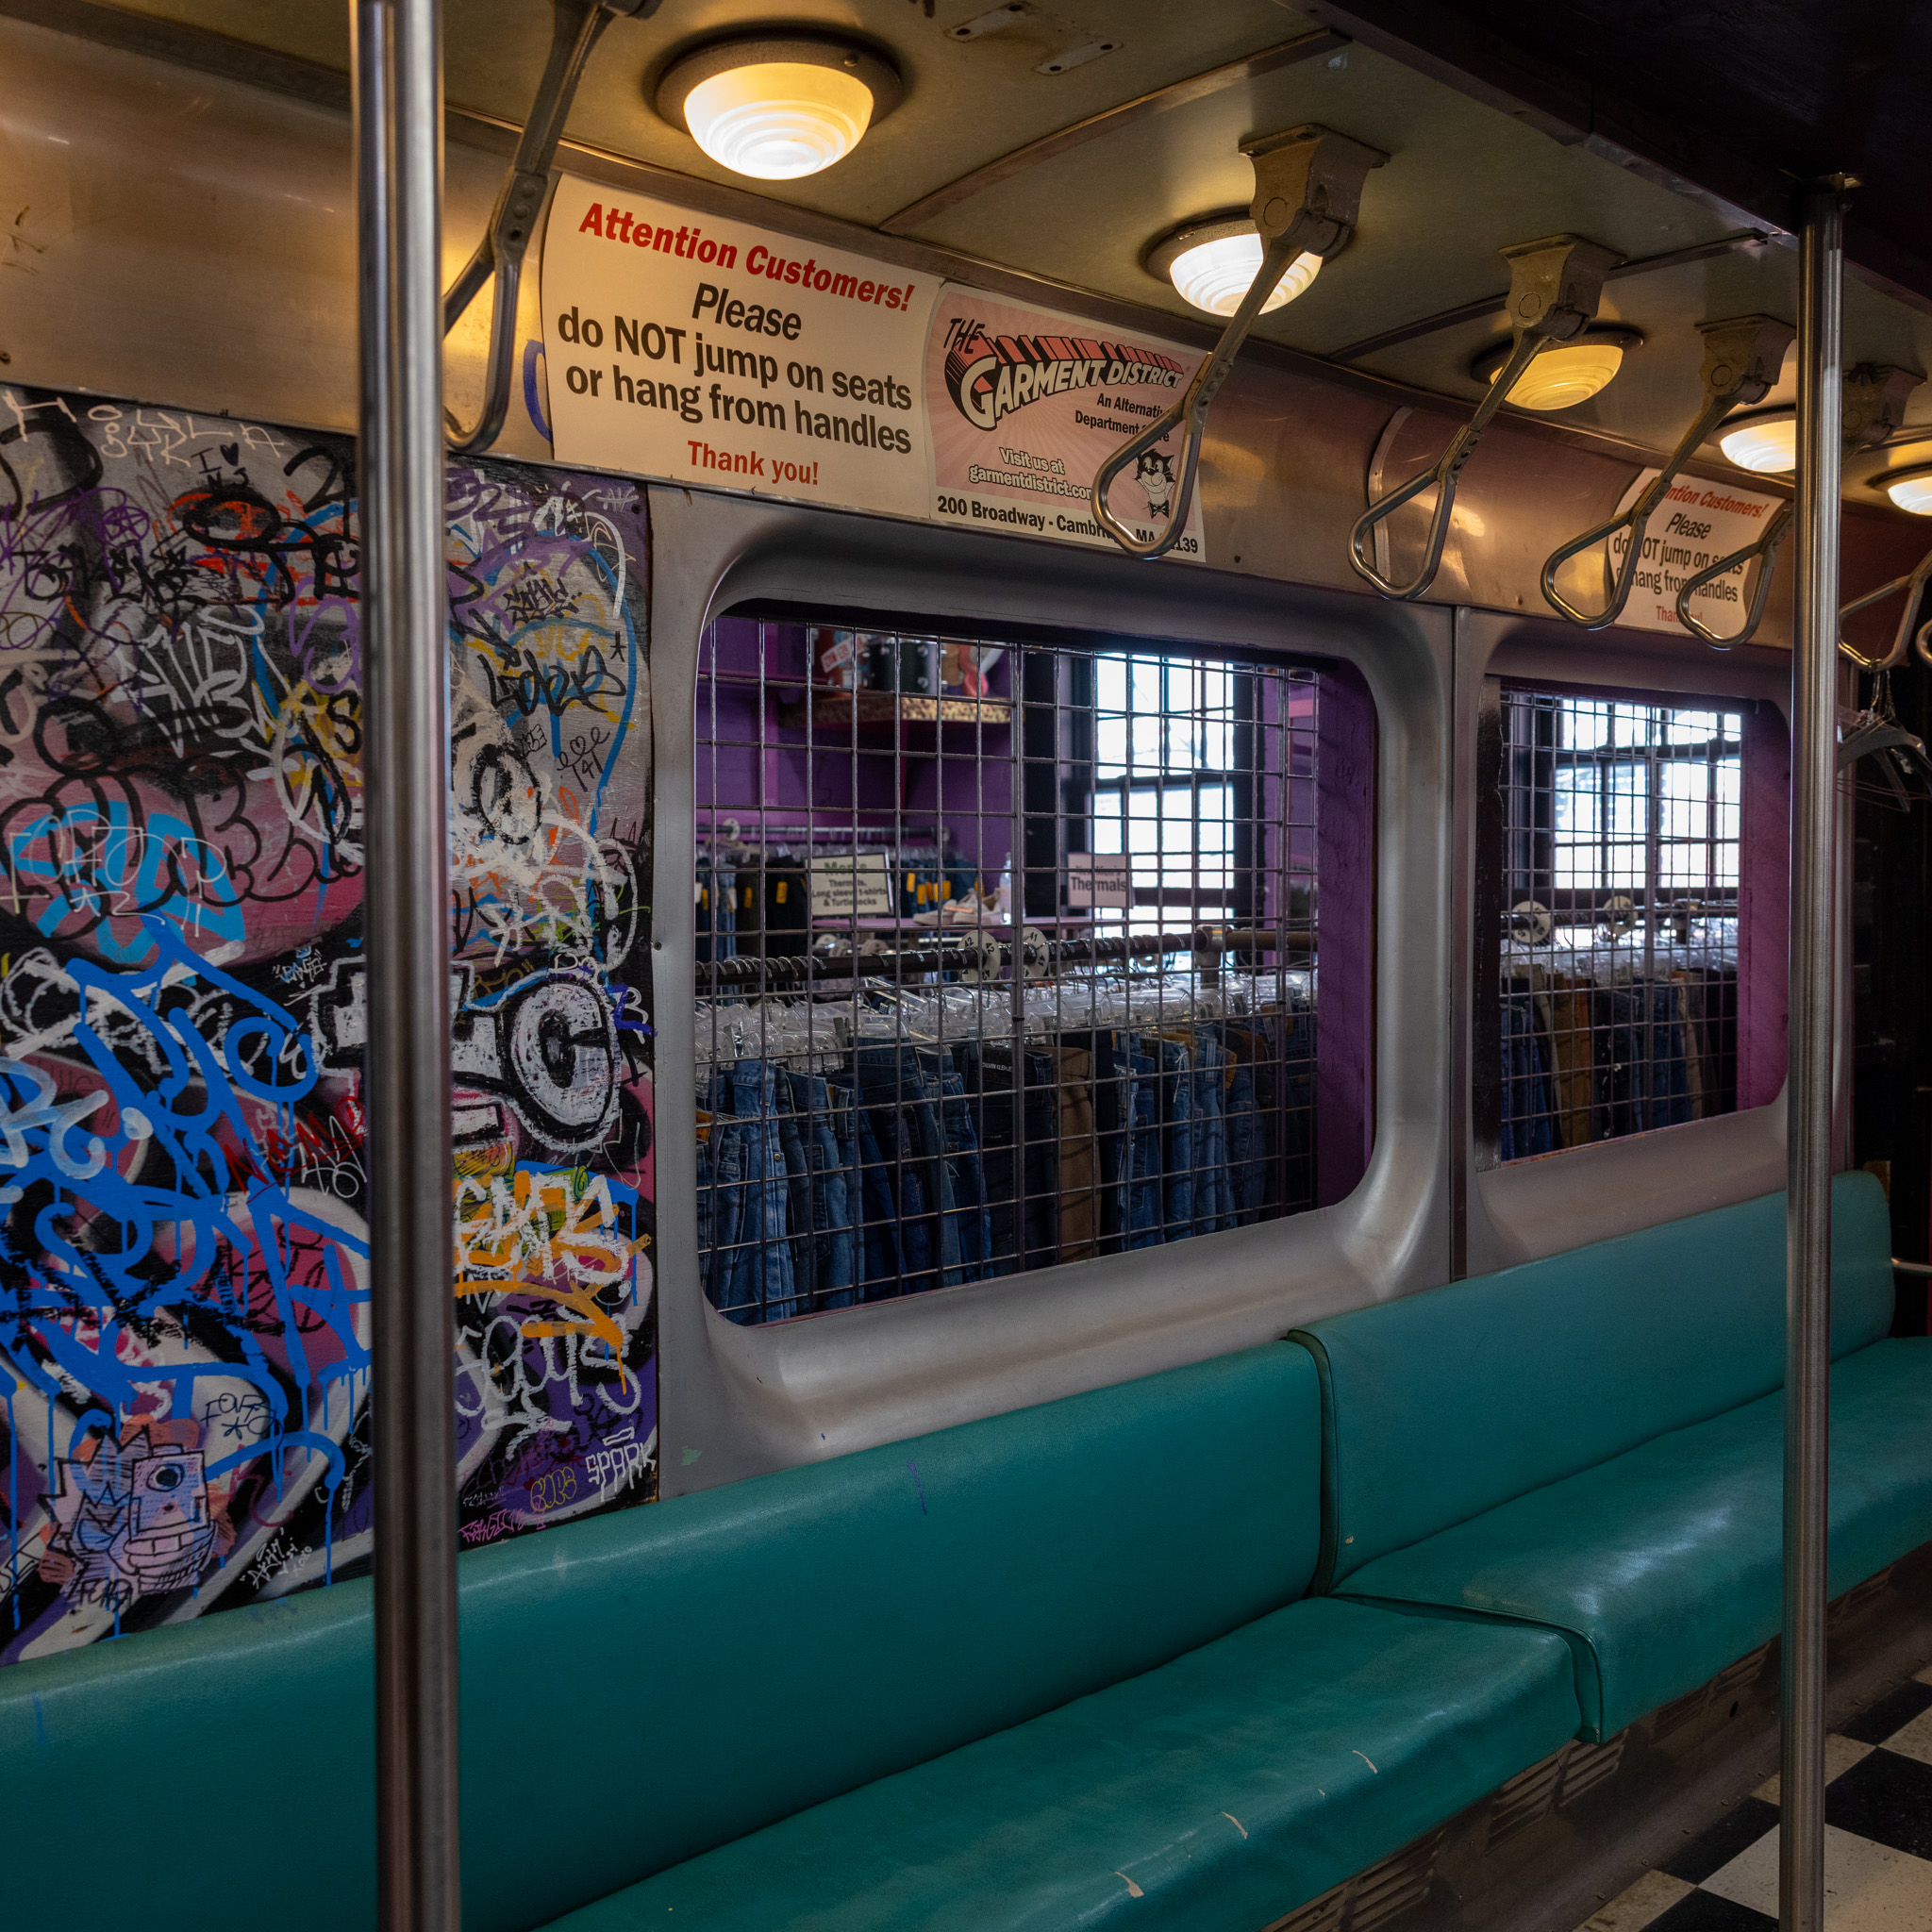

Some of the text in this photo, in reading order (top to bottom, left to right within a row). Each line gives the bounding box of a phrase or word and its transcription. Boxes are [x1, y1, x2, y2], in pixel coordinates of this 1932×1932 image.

[578, 202, 915, 312] Attention Customers!
[691, 282, 802, 341] Please
[943, 318, 986, 354] THE
[558, 306, 912, 410] do NOT jump on seats
[959, 354, 1184, 432] GARMENT DISTRICT
[1097, 392, 1166, 418] An Alternati
[566, 364, 912, 454] or hang from handles
[1075, 410, 1140, 436] Department
[688, 440, 819, 486] Thank you!
[999, 447, 1064, 475] Visit us at
[1700, 491, 1769, 518] Customers!
[938, 495, 967, 516] 200
[972, 501, 1044, 531] Broadway
[1057, 514, 1115, 543] Cambr
[1136, 528, 1156, 543] MA
[1665, 512, 1712, 539] Please
[1638, 537, 1660, 560] OT
[1659, 540, 1691, 570] jump
[1693, 552, 1709, 568] on
[1656, 605, 1679, 623] Than
[828, 879, 867, 888] Thermls,
[833, 889, 855, 897] sleev
[832, 897, 877, 907] Turtleecks
[964, 937, 974, 948] 42
